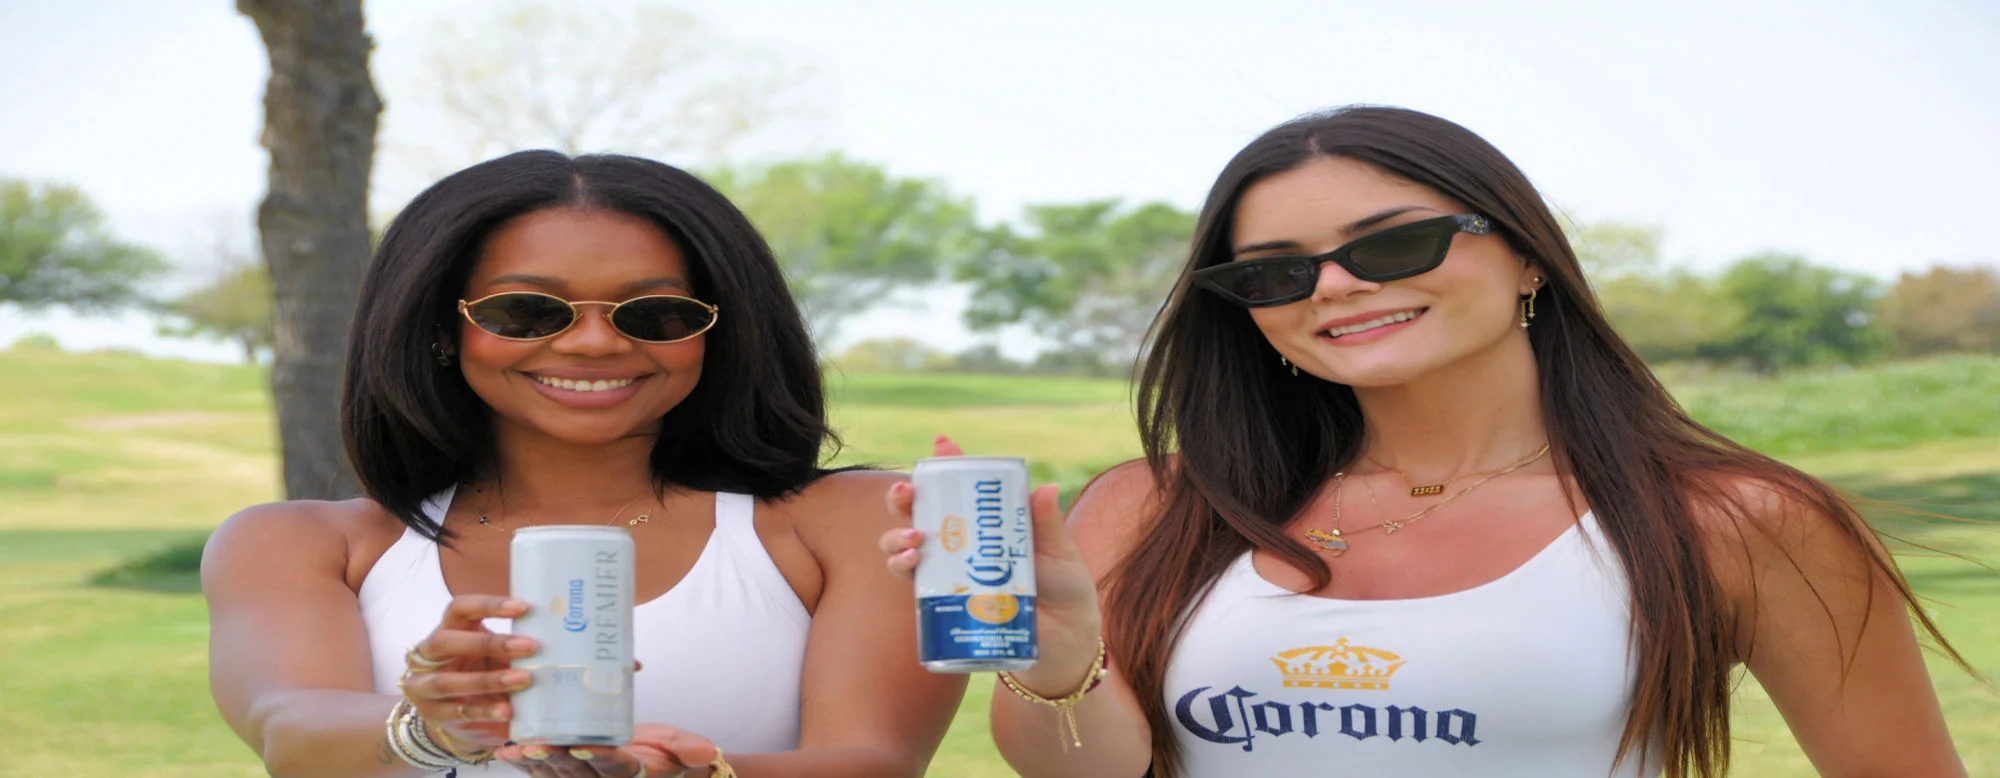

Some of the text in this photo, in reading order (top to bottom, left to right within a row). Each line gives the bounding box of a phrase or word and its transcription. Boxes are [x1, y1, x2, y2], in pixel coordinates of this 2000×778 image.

[966, 480, 1017, 587] Corona
[1009, 507, 1028, 557] Extra
[563, 578, 589, 633] Corona
[596, 550, 619, 661] PREMIER
[1175, 685, 1483, 753] Corona
